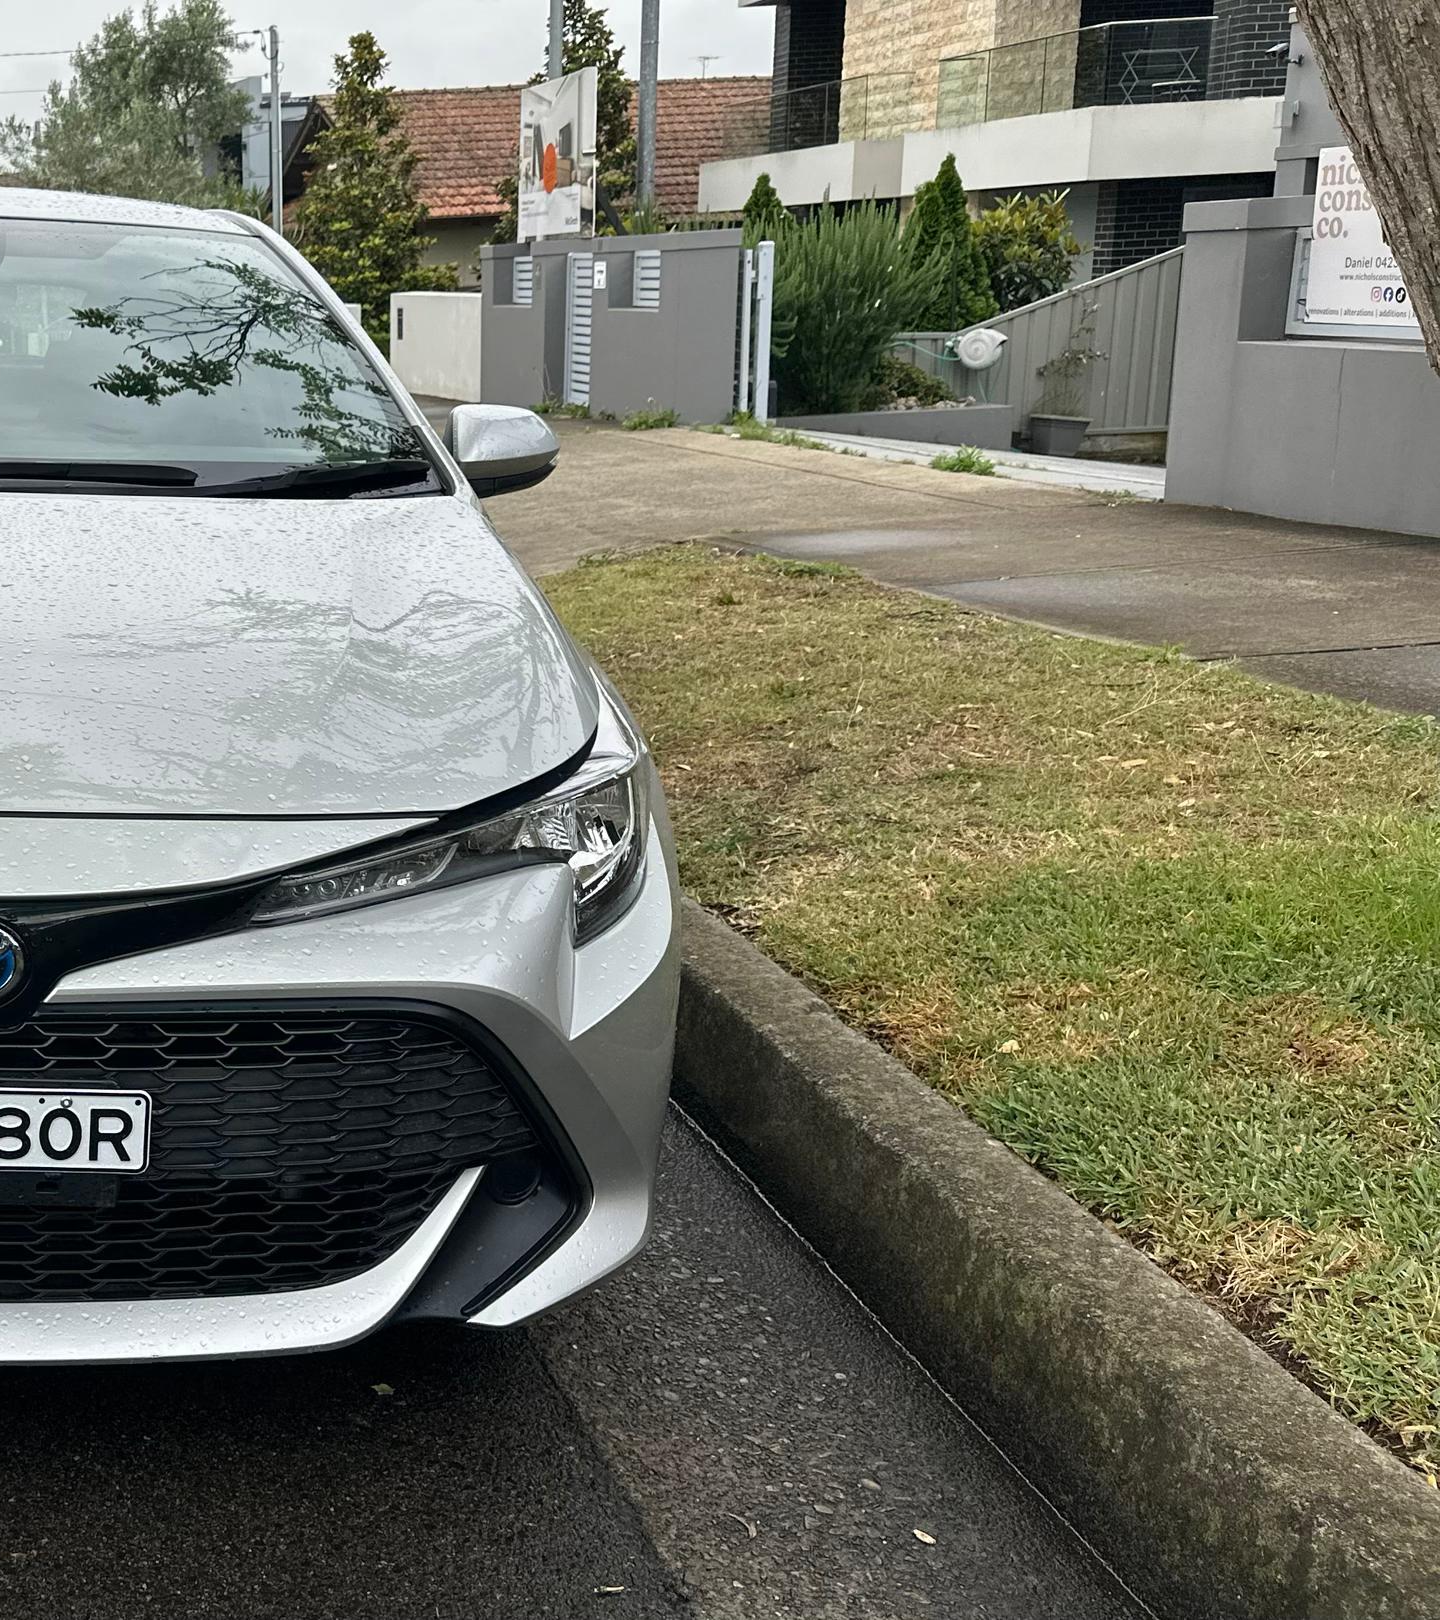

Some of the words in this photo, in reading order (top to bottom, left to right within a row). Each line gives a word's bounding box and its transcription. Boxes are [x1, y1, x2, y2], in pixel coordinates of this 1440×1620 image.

[1321, 155, 1365, 186] nic
[1316, 217, 1348, 238] co.
[1344, 256, 1373, 269] Daniel
[1308, 308, 1339, 317] renovations
[1343, 309, 1374, 318] alterations
[1379, 309, 1407, 319] additions
